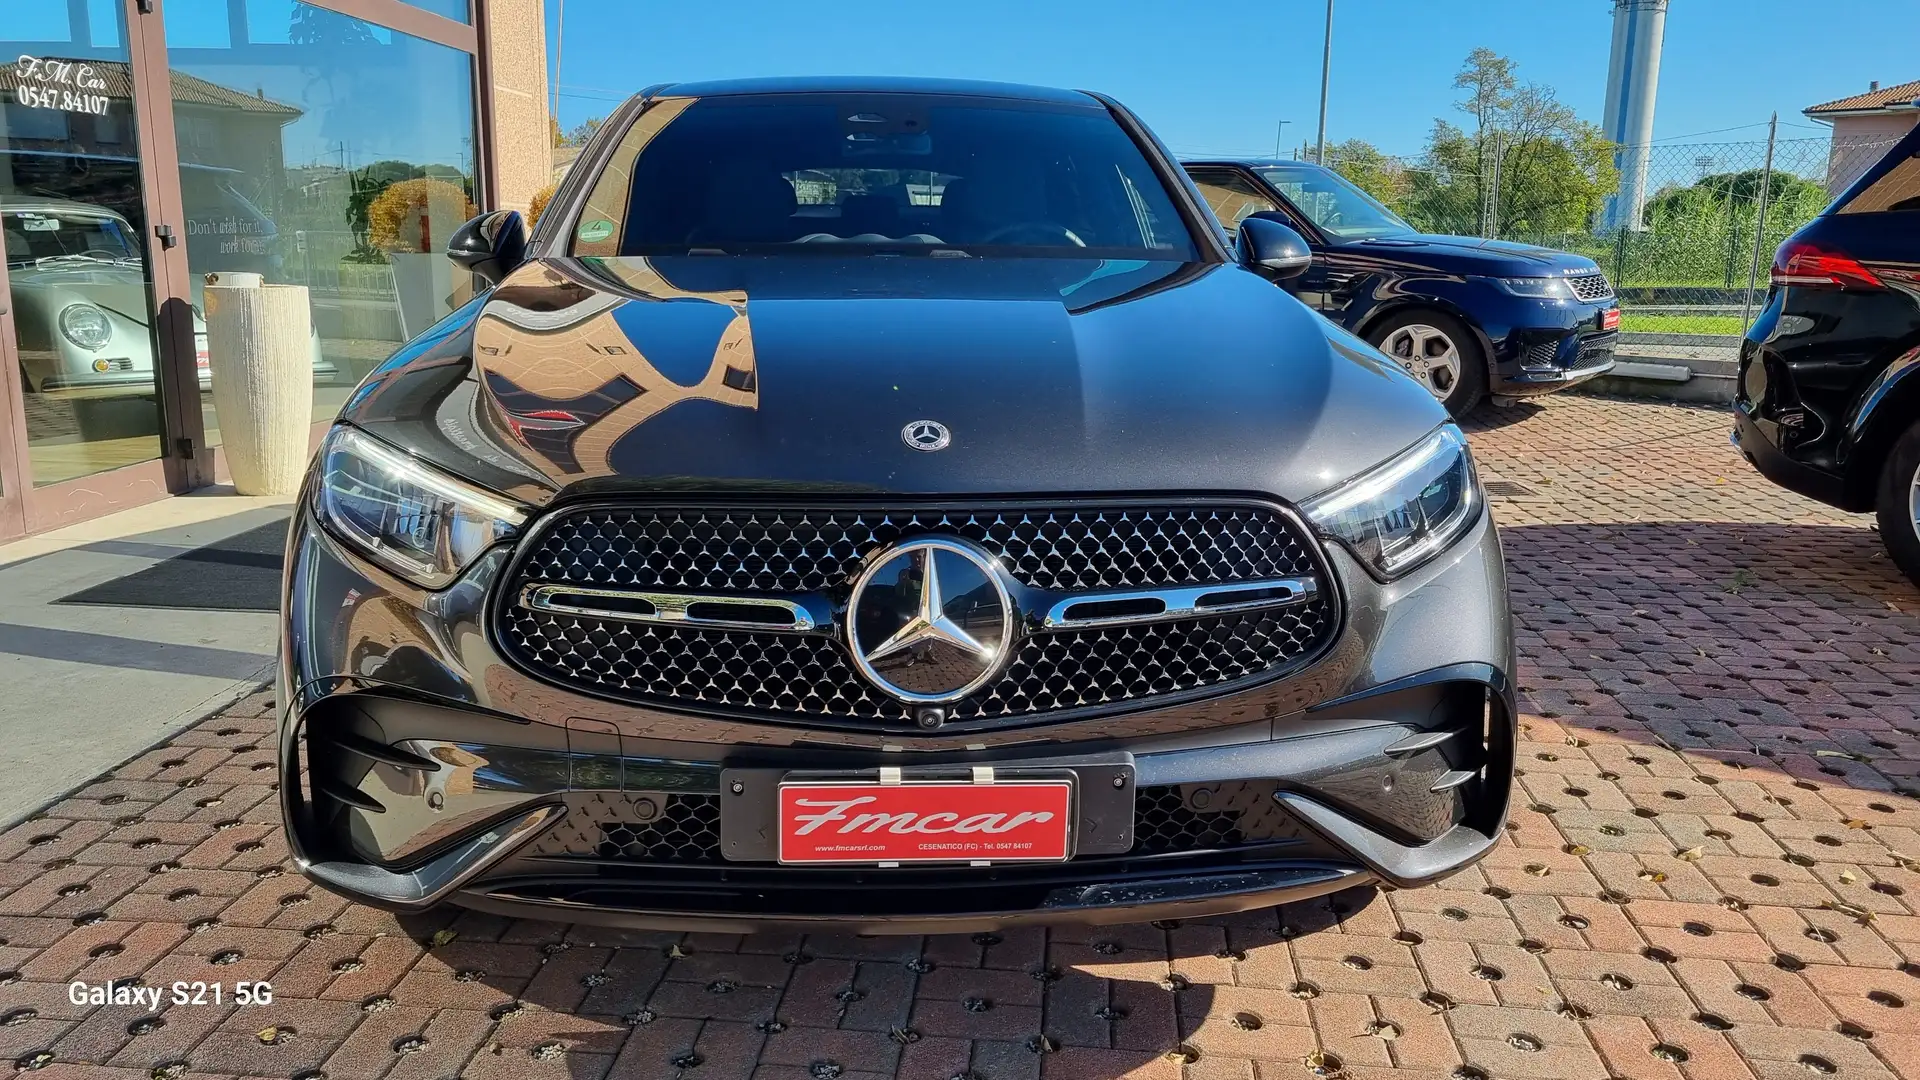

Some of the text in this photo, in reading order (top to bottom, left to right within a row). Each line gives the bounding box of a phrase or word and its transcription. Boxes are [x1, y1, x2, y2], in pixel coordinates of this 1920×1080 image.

[77, 63, 107, 89] Car
[18, 85, 109, 116] 0547.84107
[188, 218, 217, 235] Don't
[220, 216, 236, 234] wish
[239, 218, 252, 234] for
[220, 235, 238, 254] work
[794, 796, 1055, 836] Fmcar
[815, 844, 886, 852] www.fmcarsrl.com
[964, 843, 978, 851] (FC)
[984, 842, 995, 850] Tel.
[996, 842, 1012, 850] 0547
[1013, 842, 1033, 850] 84107
